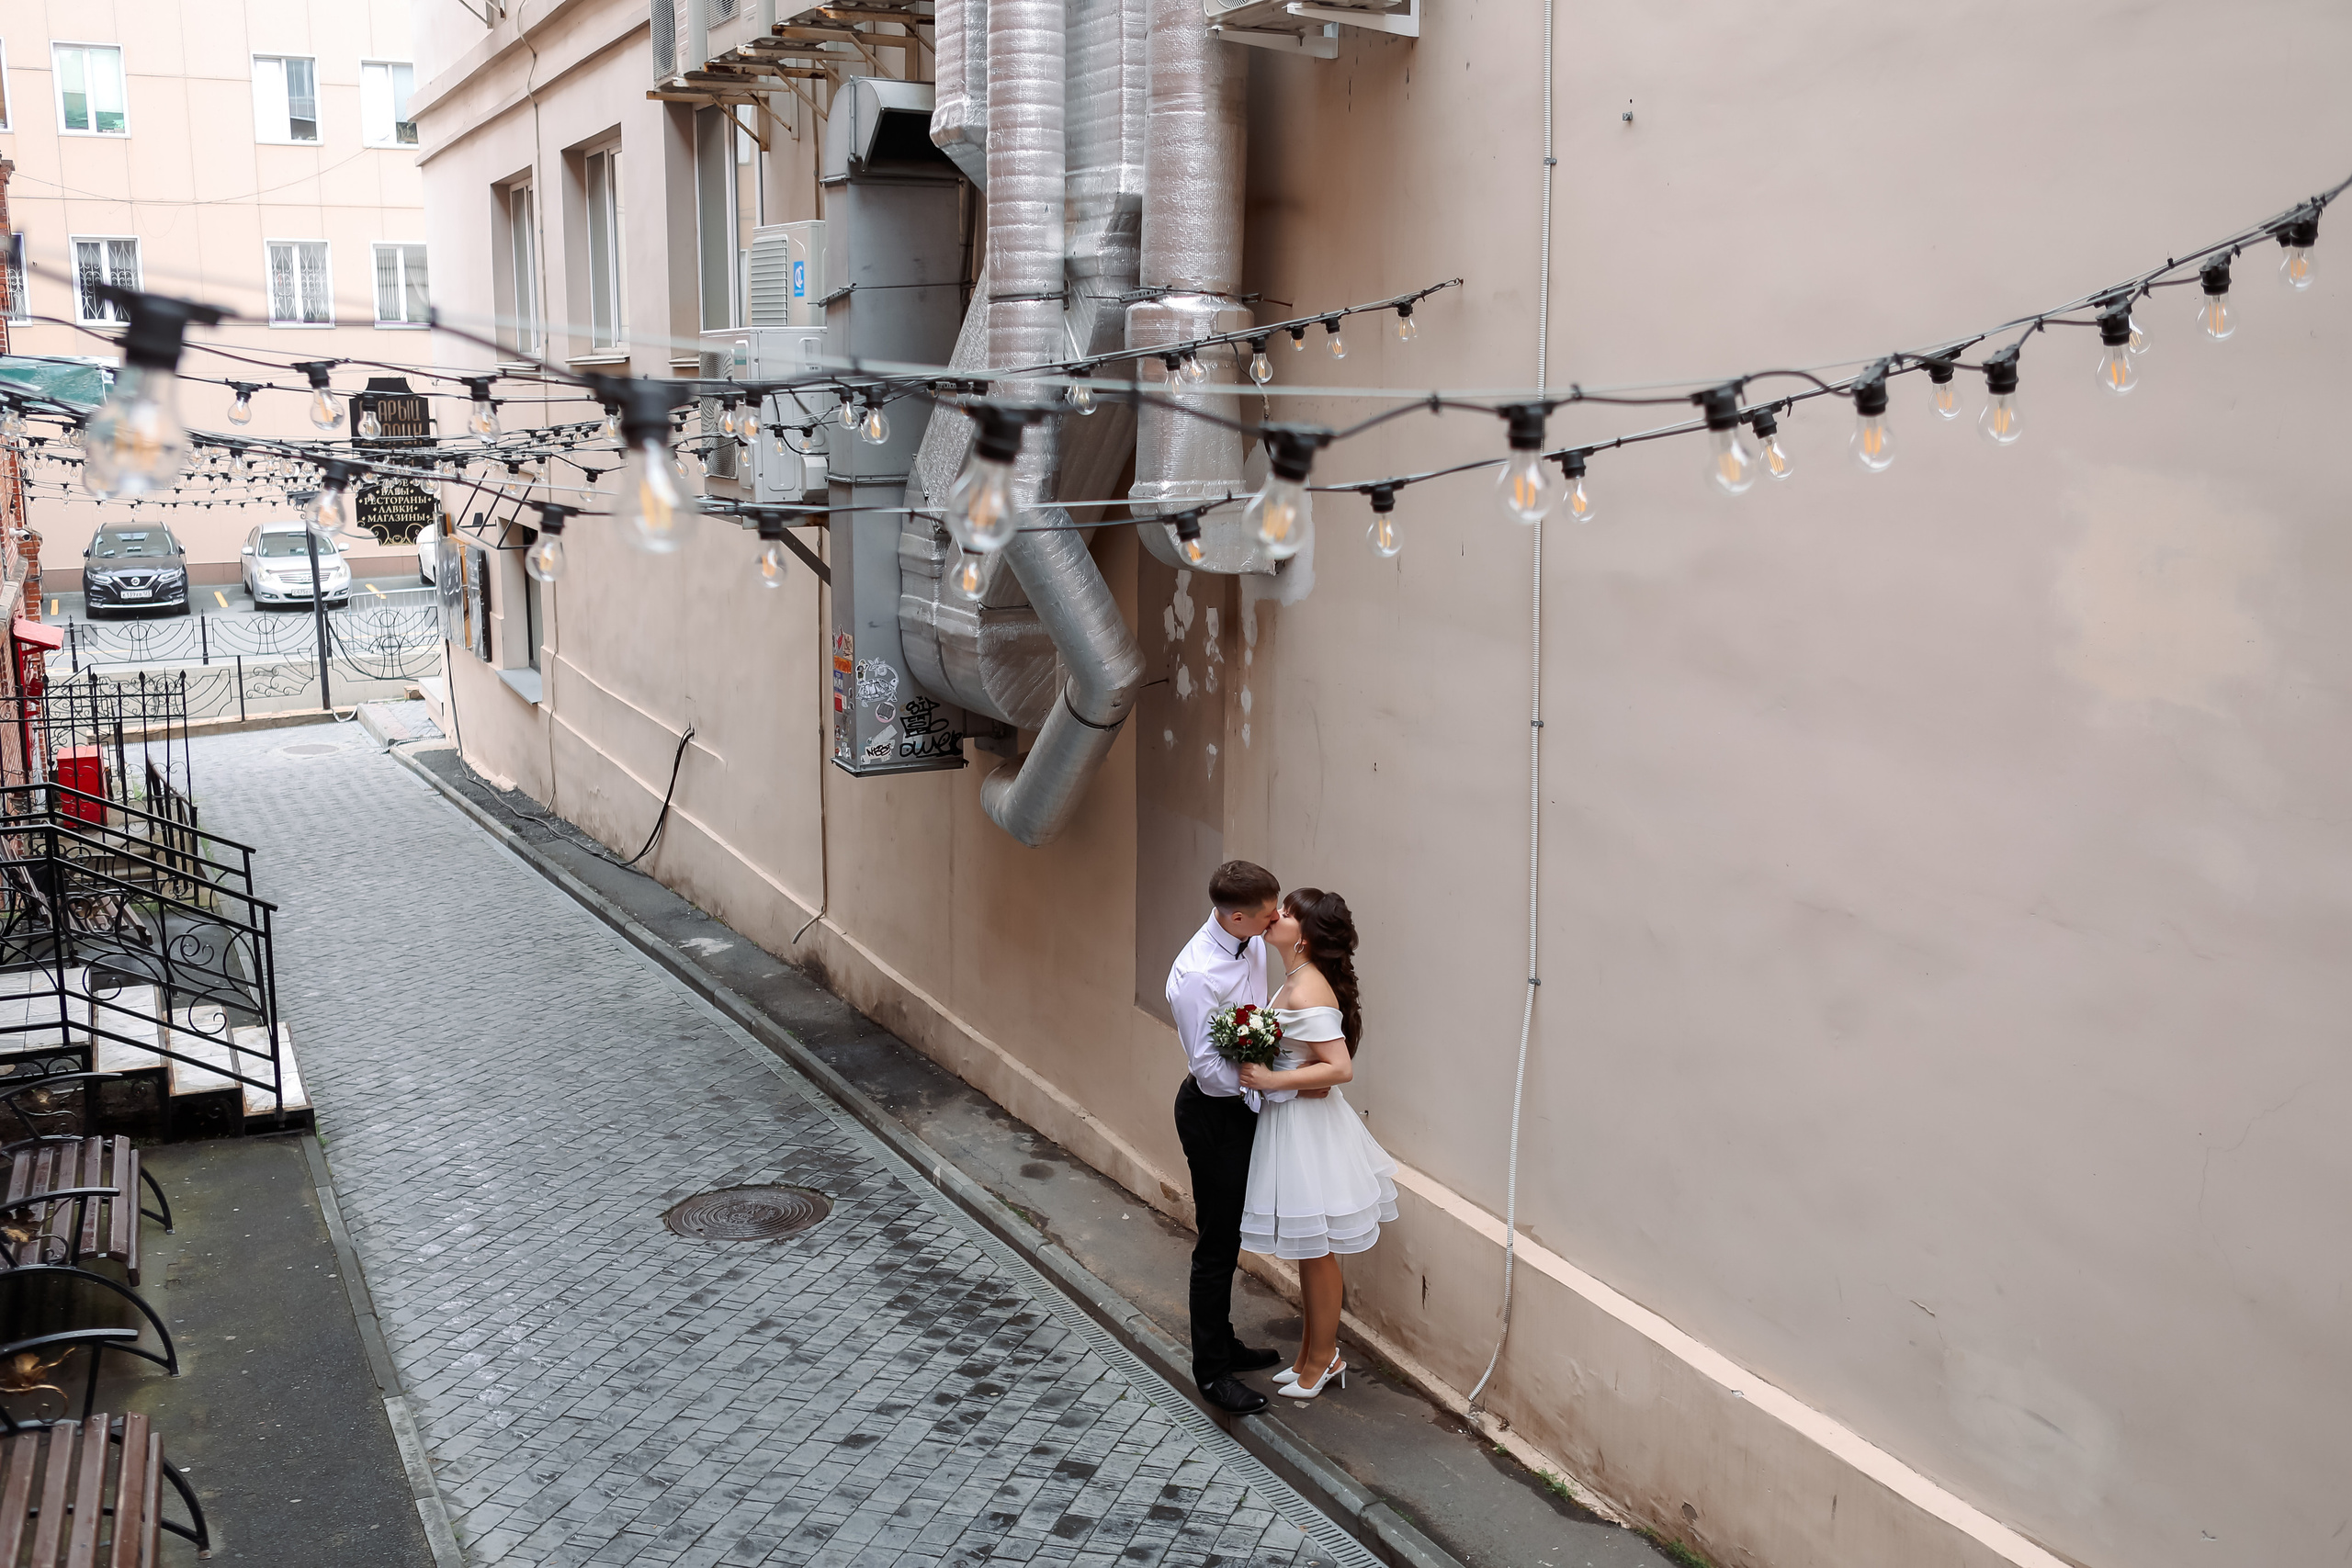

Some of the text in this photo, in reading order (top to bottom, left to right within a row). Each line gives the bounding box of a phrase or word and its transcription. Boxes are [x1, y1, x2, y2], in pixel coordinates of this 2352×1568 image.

[359, 397, 421, 422] АРЫЙ
[364, 496, 427, 505] РЕСТОРАНЫ
[379, 505, 413, 513] ЛАВКИ
[368, 513, 425, 523] МАГАЗИНЫ
